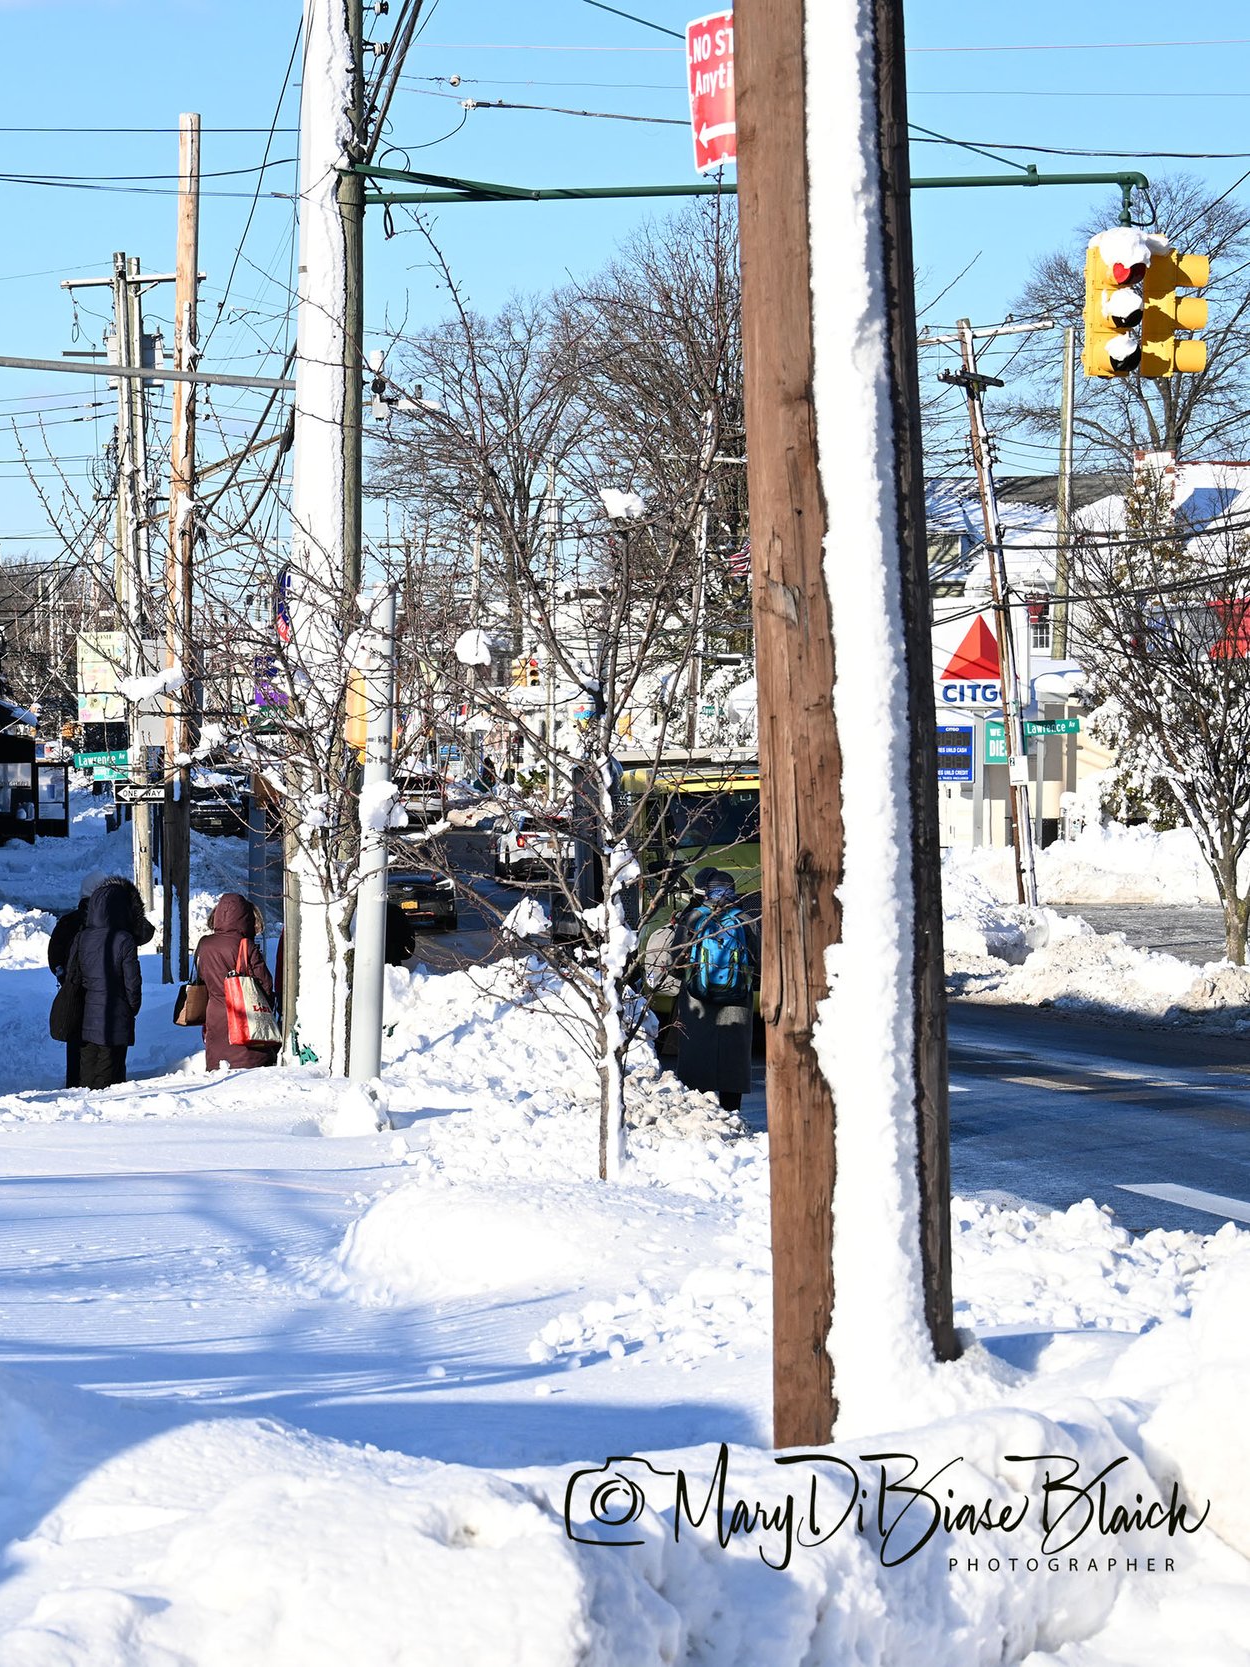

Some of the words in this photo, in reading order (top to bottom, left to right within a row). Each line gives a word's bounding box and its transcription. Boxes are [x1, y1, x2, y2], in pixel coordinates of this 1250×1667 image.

[693, 33, 711, 64] NO
[943, 684, 1002, 702] CITG
[990, 728, 1001, 736] WE
[1027, 723, 1066, 734] Lawrence
[990, 740, 1007, 757] DIE
[78, 755, 116, 766] Lawrence
